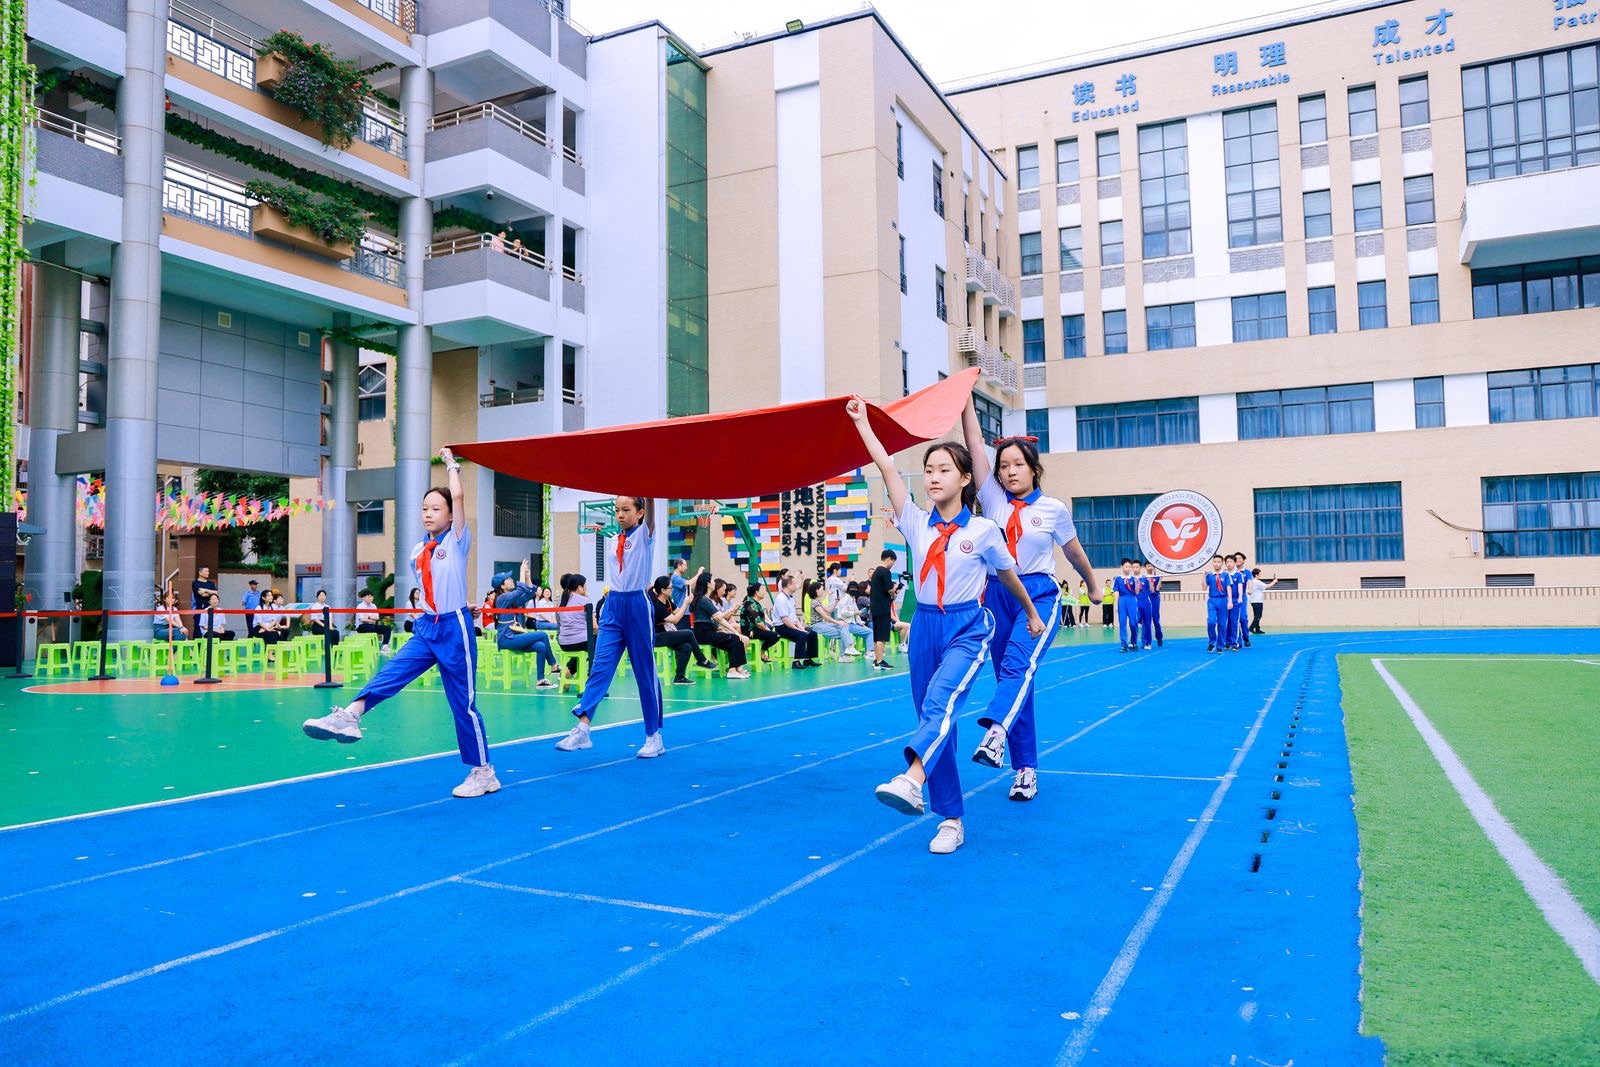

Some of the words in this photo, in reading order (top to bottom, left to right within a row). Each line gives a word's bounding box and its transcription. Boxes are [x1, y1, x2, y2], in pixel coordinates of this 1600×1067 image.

[1372, 9, 1454, 47] 成才
[1213, 41, 1288, 76] 明理
[1373, 38, 1456, 65] Talented
[1071, 74, 1138, 106] 读书
[1210, 71, 1291, 97] Reasonable
[1071, 99, 1140, 123] Educated
[816, 484, 825, 528] WORLD
[816, 530, 825, 554] ONE
[816, 556, 826, 588] HOM
